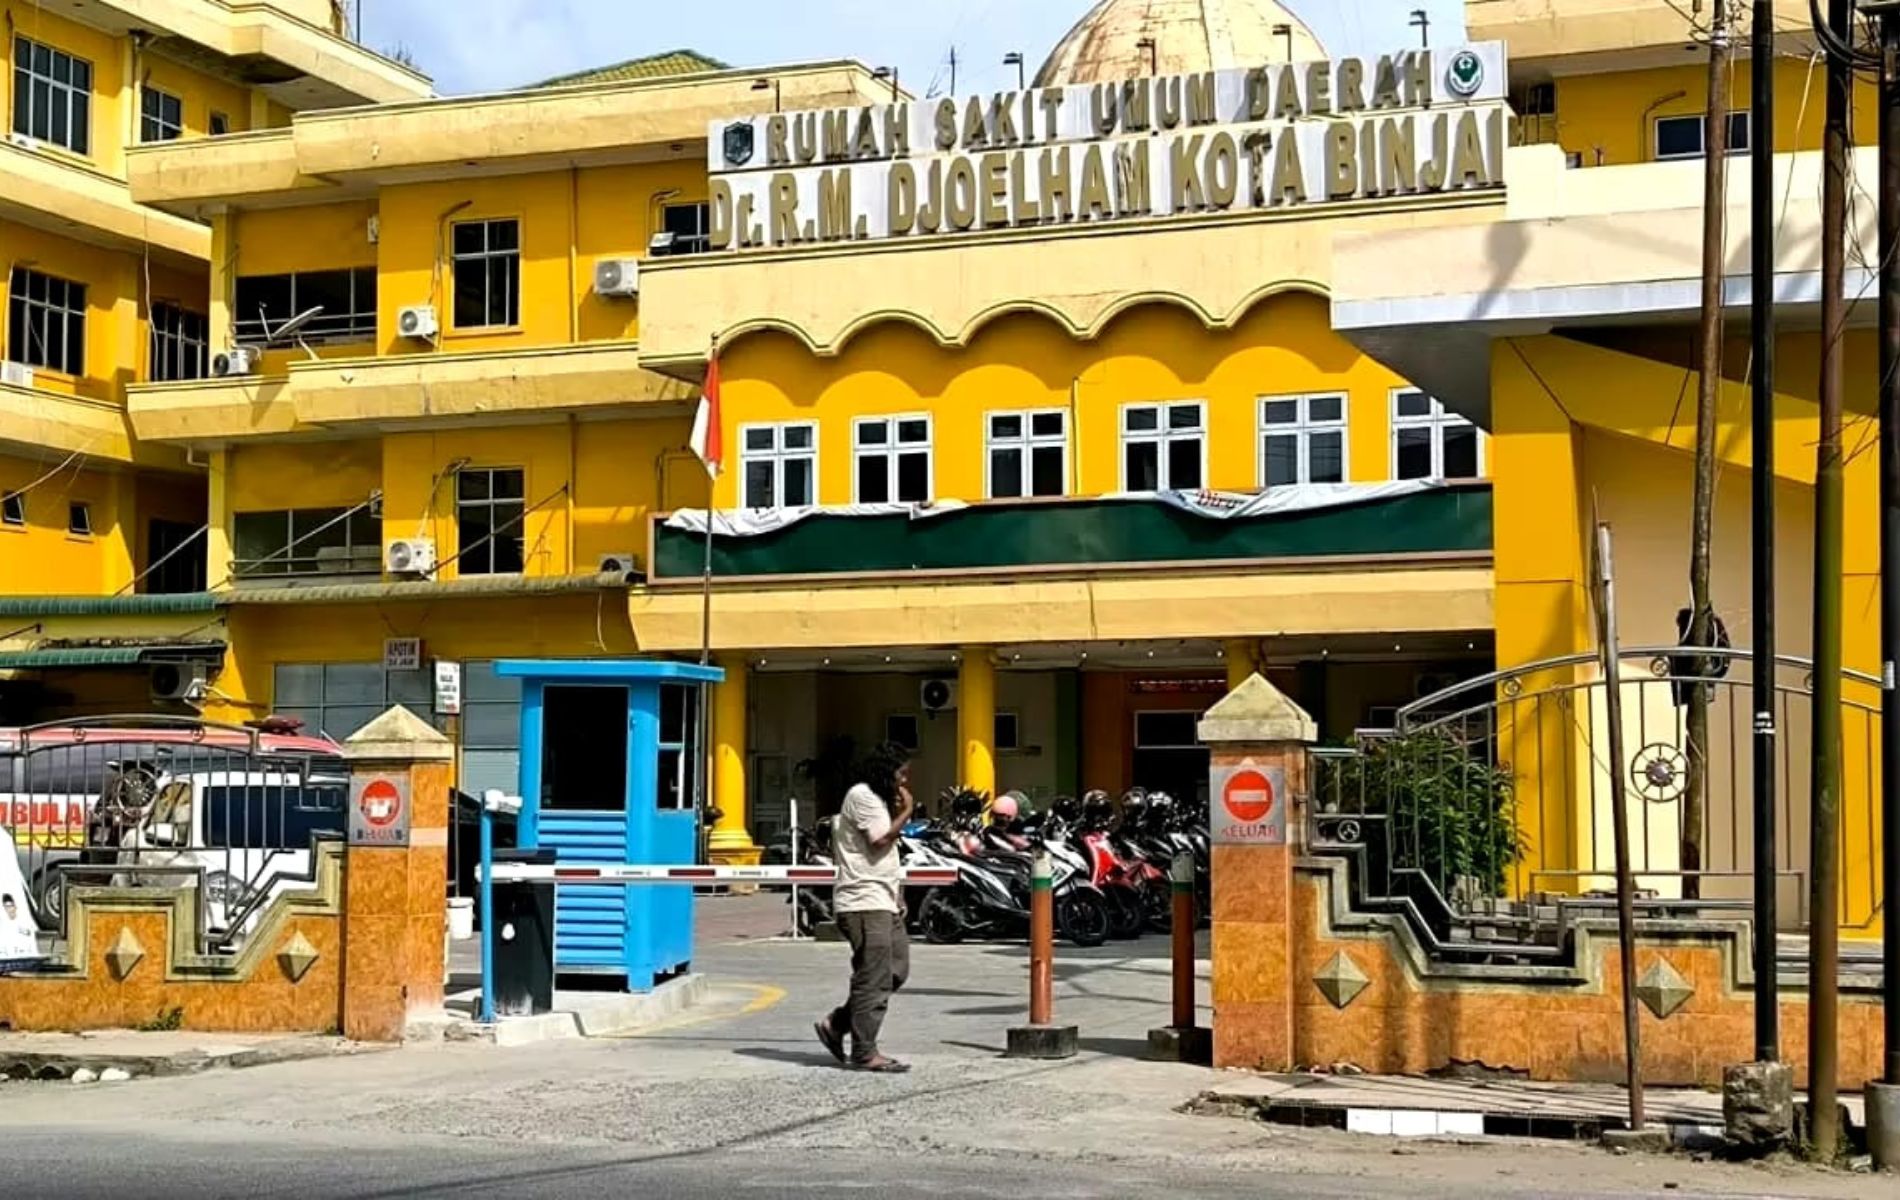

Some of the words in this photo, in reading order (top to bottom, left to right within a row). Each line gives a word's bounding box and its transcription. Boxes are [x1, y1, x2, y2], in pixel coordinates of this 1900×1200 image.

[767, 101, 909, 164] RUMAH
[934, 86, 1064, 152] SAKIT
[1091, 70, 1216, 135] UMUM
[1243, 51, 1432, 120] DAERAH
[888, 138, 1150, 233] DJOELHAM
[1171, 126, 1306, 213] KOTA
[1324, 108, 1505, 198] BINJAI
